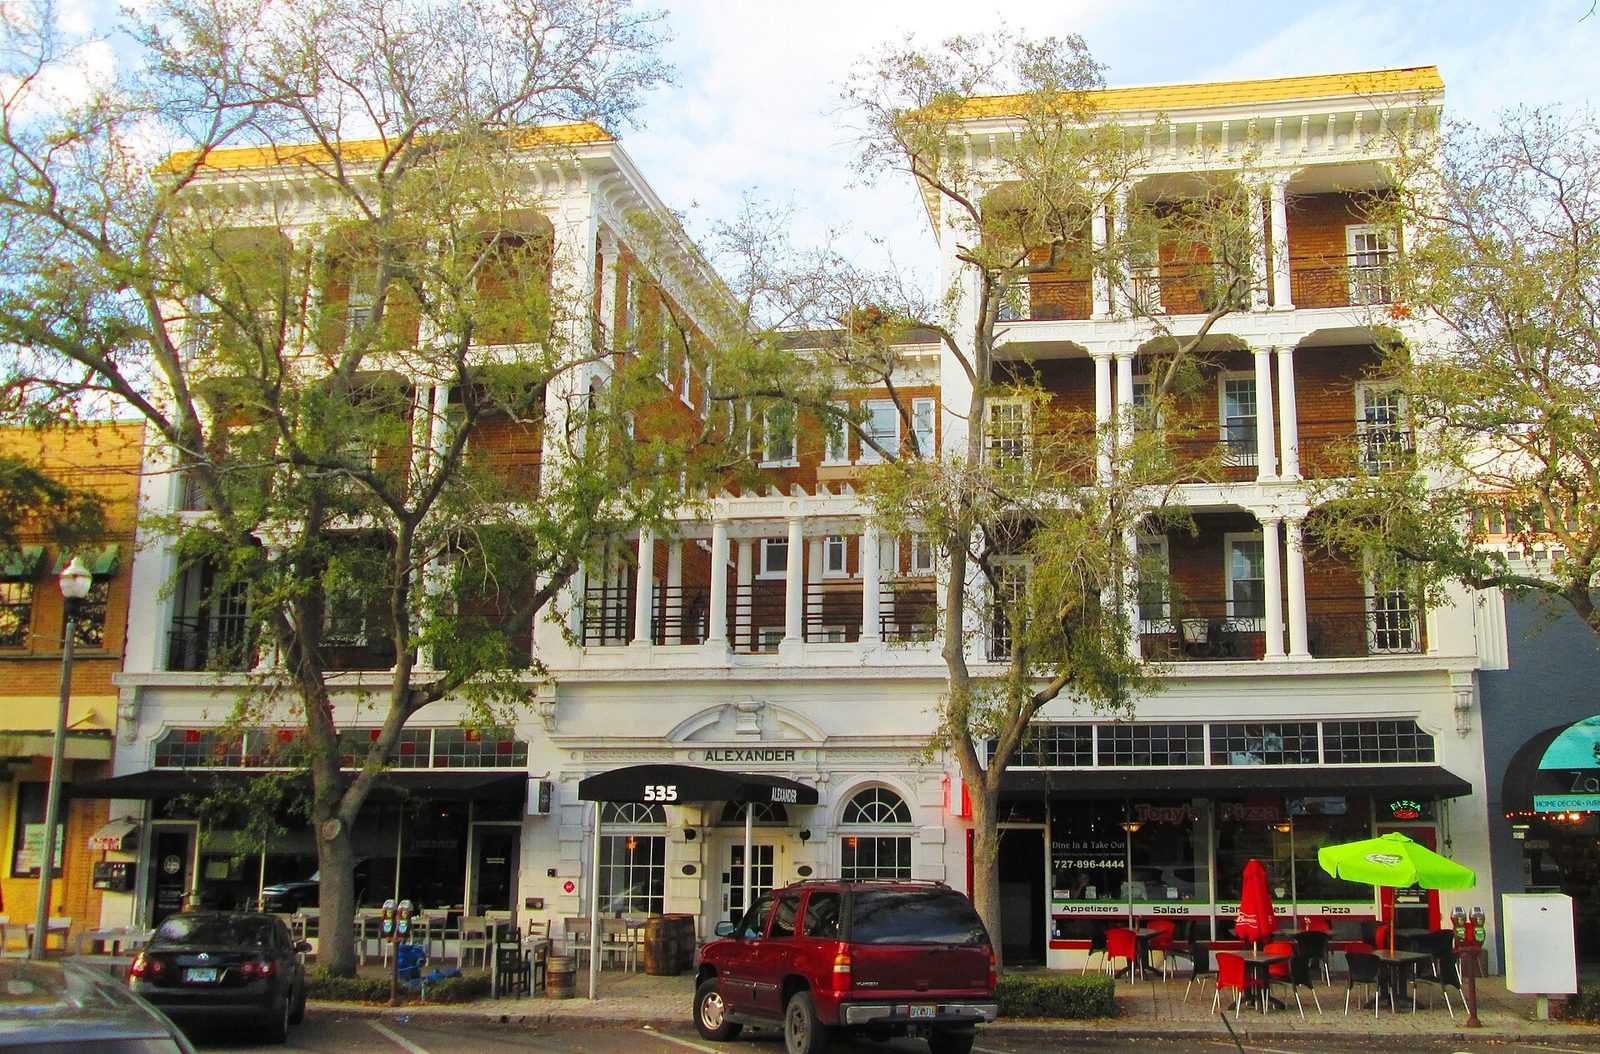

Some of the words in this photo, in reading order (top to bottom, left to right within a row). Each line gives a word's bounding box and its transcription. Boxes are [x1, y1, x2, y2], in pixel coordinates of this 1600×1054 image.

[704, 750, 795, 761] ALEXANDER
[643, 785, 678, 802] 535
[770, 786, 797, 803] ALEXANDER
[1390, 800, 1420, 811] PIZZA
[1221, 803, 1279, 821] Pizza
[1052, 841, 1070, 849] Dine
[1072, 841, 1080, 849] In
[1082, 841, 1088, 849] &
[1091, 840, 1109, 849] Take
[1110, 841, 1125, 849] Out
[1054, 860, 1125, 869] 727-896-4444
[1062, 905, 1119, 913] Appetizers
[1152, 906, 1190, 914] Salads
[1321, 905, 1351, 914] Pizza
